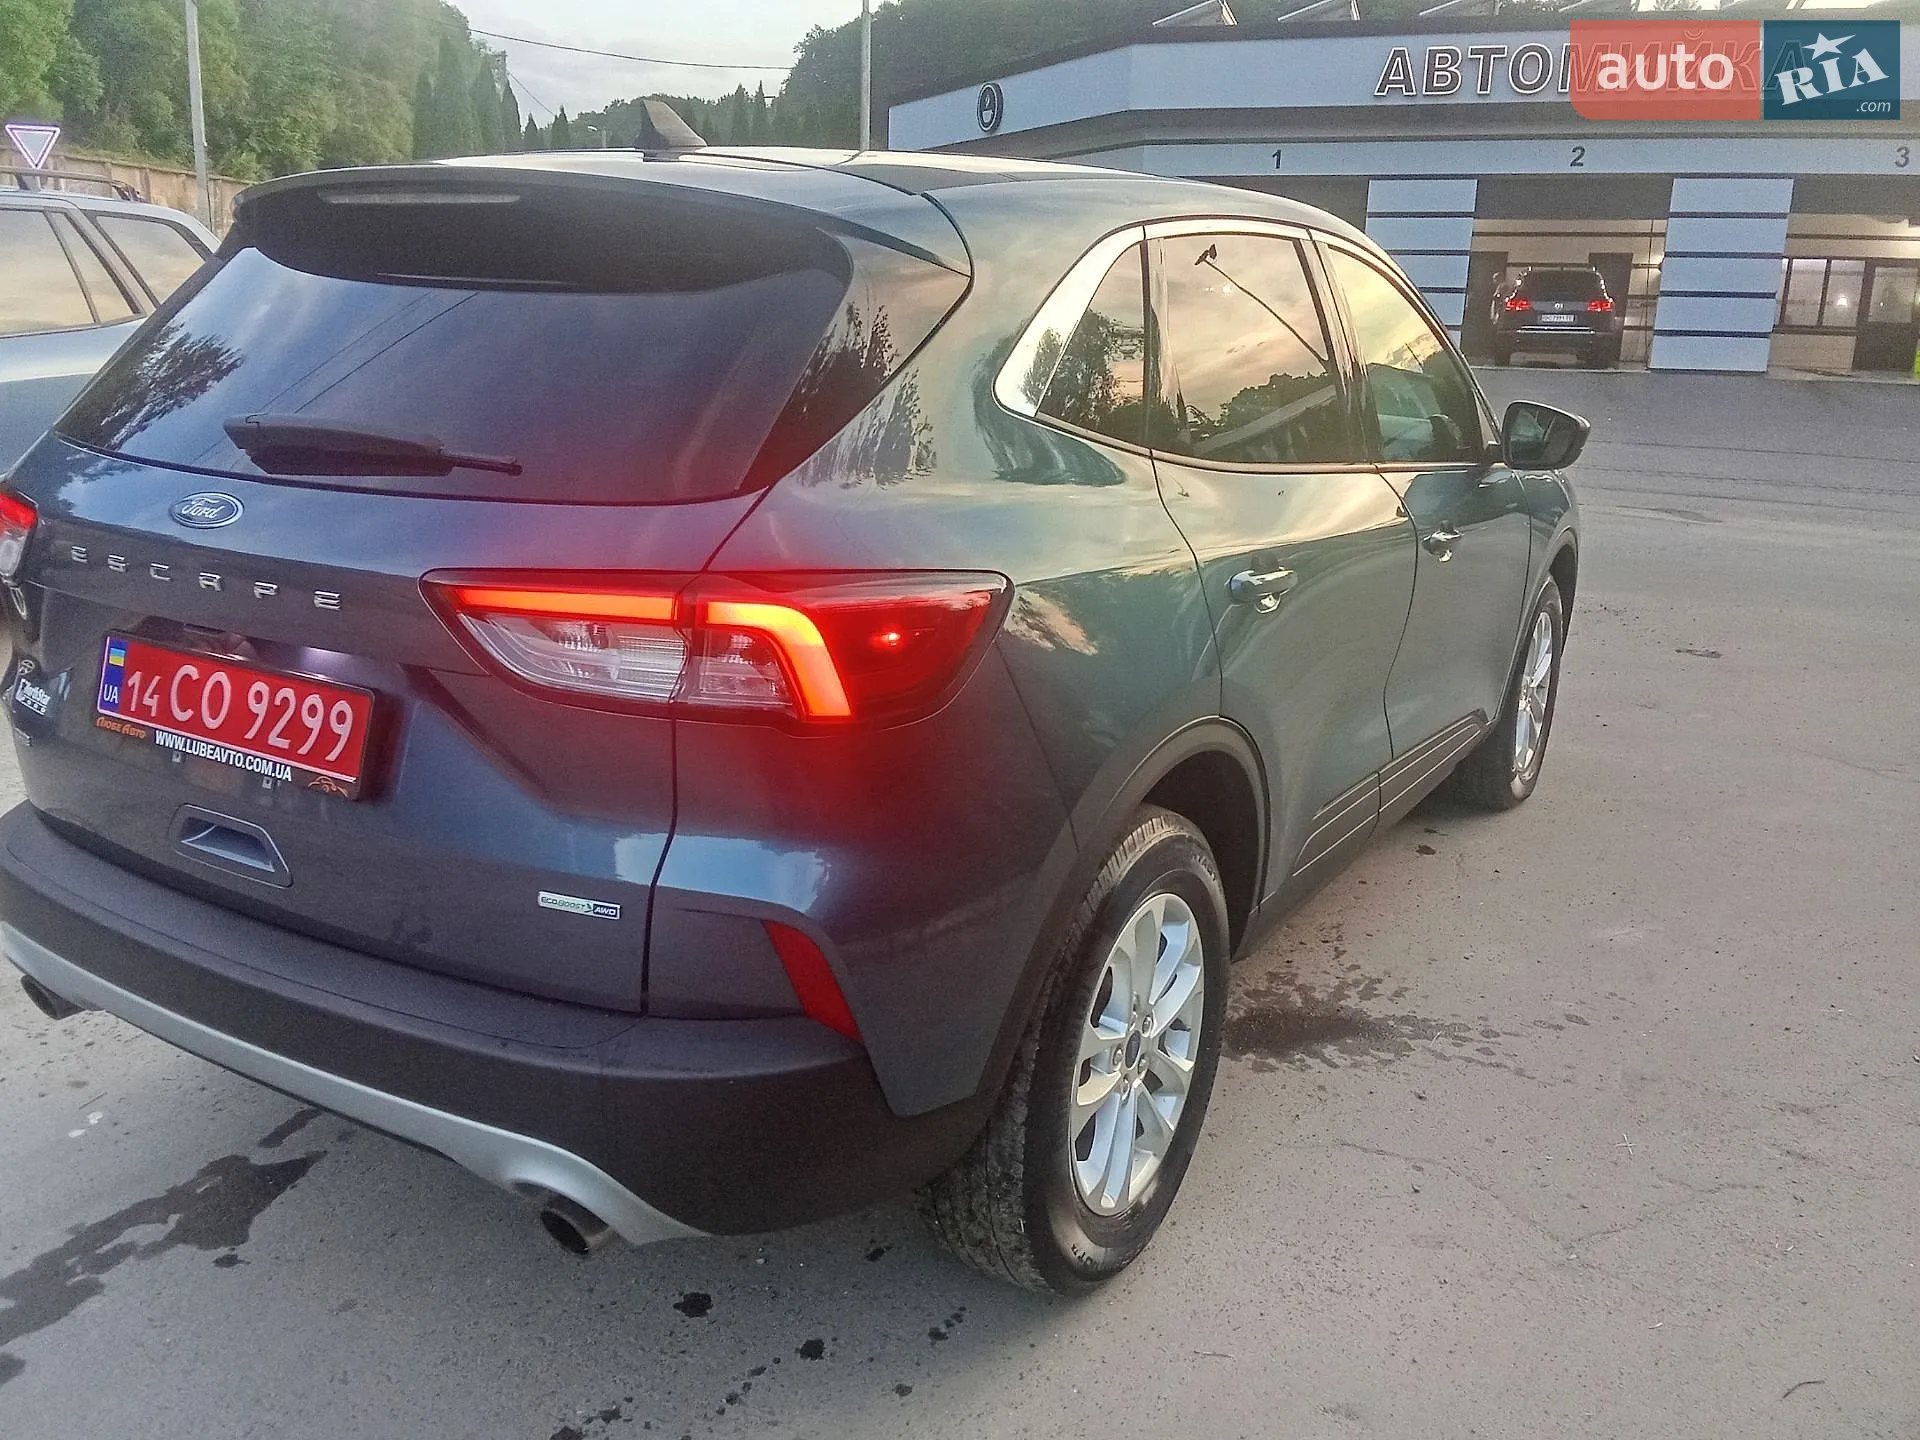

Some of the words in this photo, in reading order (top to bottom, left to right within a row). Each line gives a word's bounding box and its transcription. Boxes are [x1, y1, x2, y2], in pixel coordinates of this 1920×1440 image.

[1272, 149, 1283, 169] 1
[1569, 146, 1586, 168] 2
[1894, 146, 1911, 168] 3
[181, 497, 226, 519] Ford
[71, 545, 341, 611] ESCAPE
[103, 683, 119, 704] UA
[244, 680, 353, 762] 9299
[155, 729, 292, 782] WWW.LUBEAVTO.COM.UA
